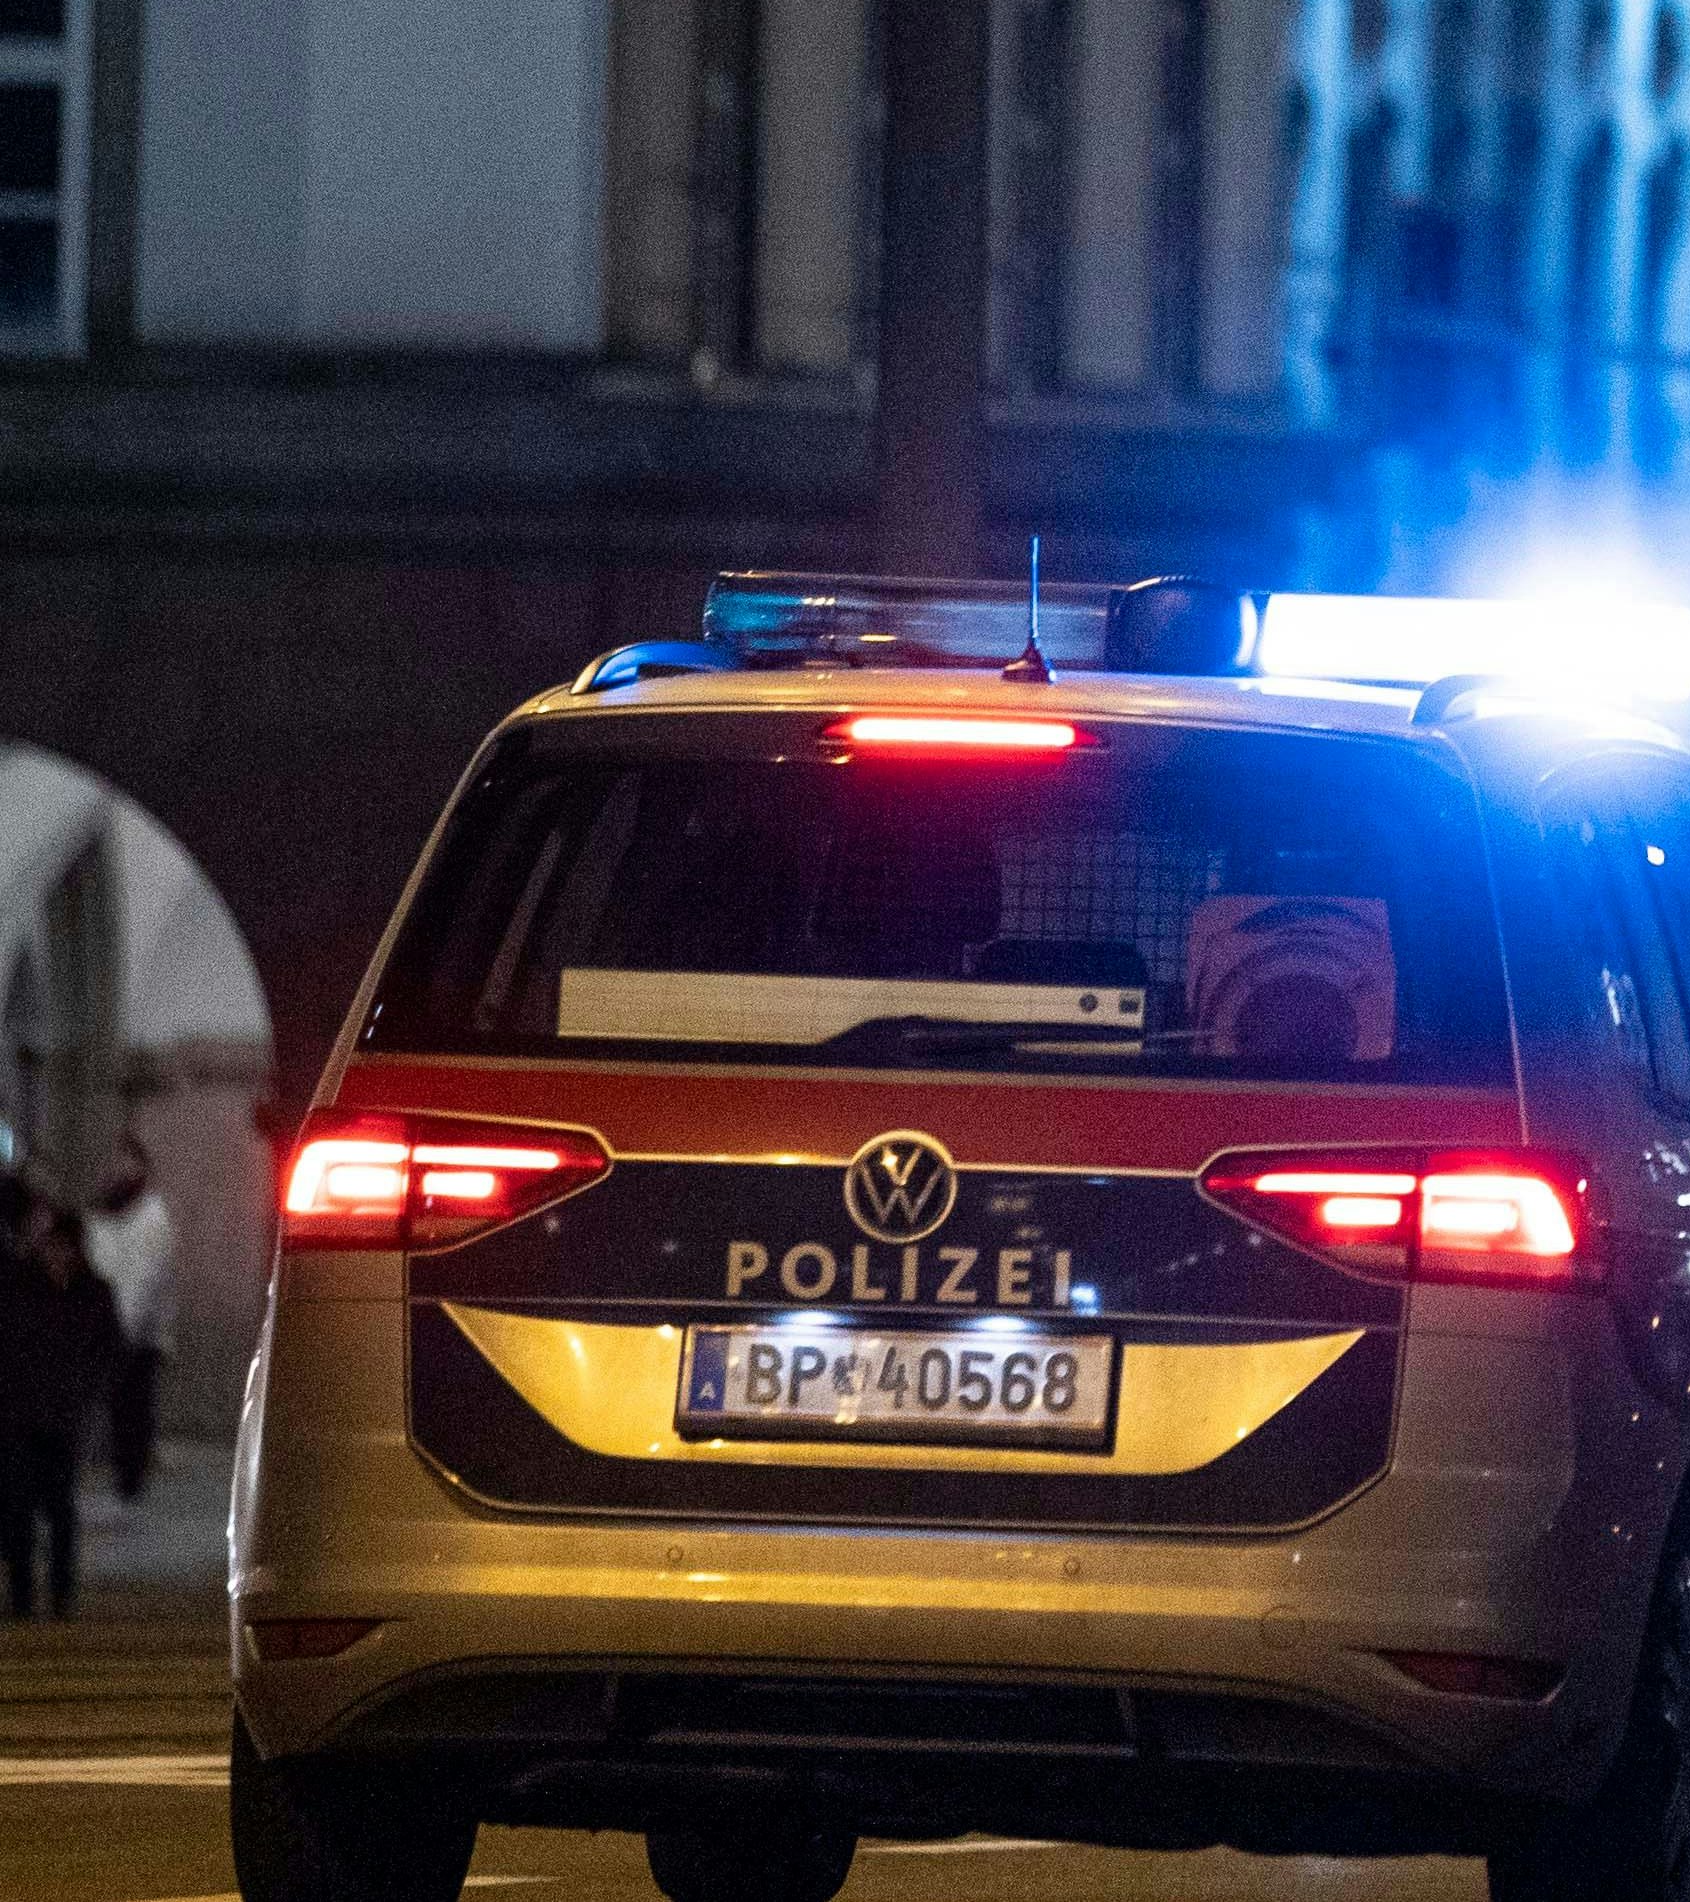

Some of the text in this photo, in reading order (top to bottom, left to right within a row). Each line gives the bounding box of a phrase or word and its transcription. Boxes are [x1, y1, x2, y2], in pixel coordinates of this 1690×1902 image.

[851, 1139, 949, 1233] VW
[726, 1240, 1071, 1306] POLIZEI
[745, 1342, 1079, 1414] BP 40568
